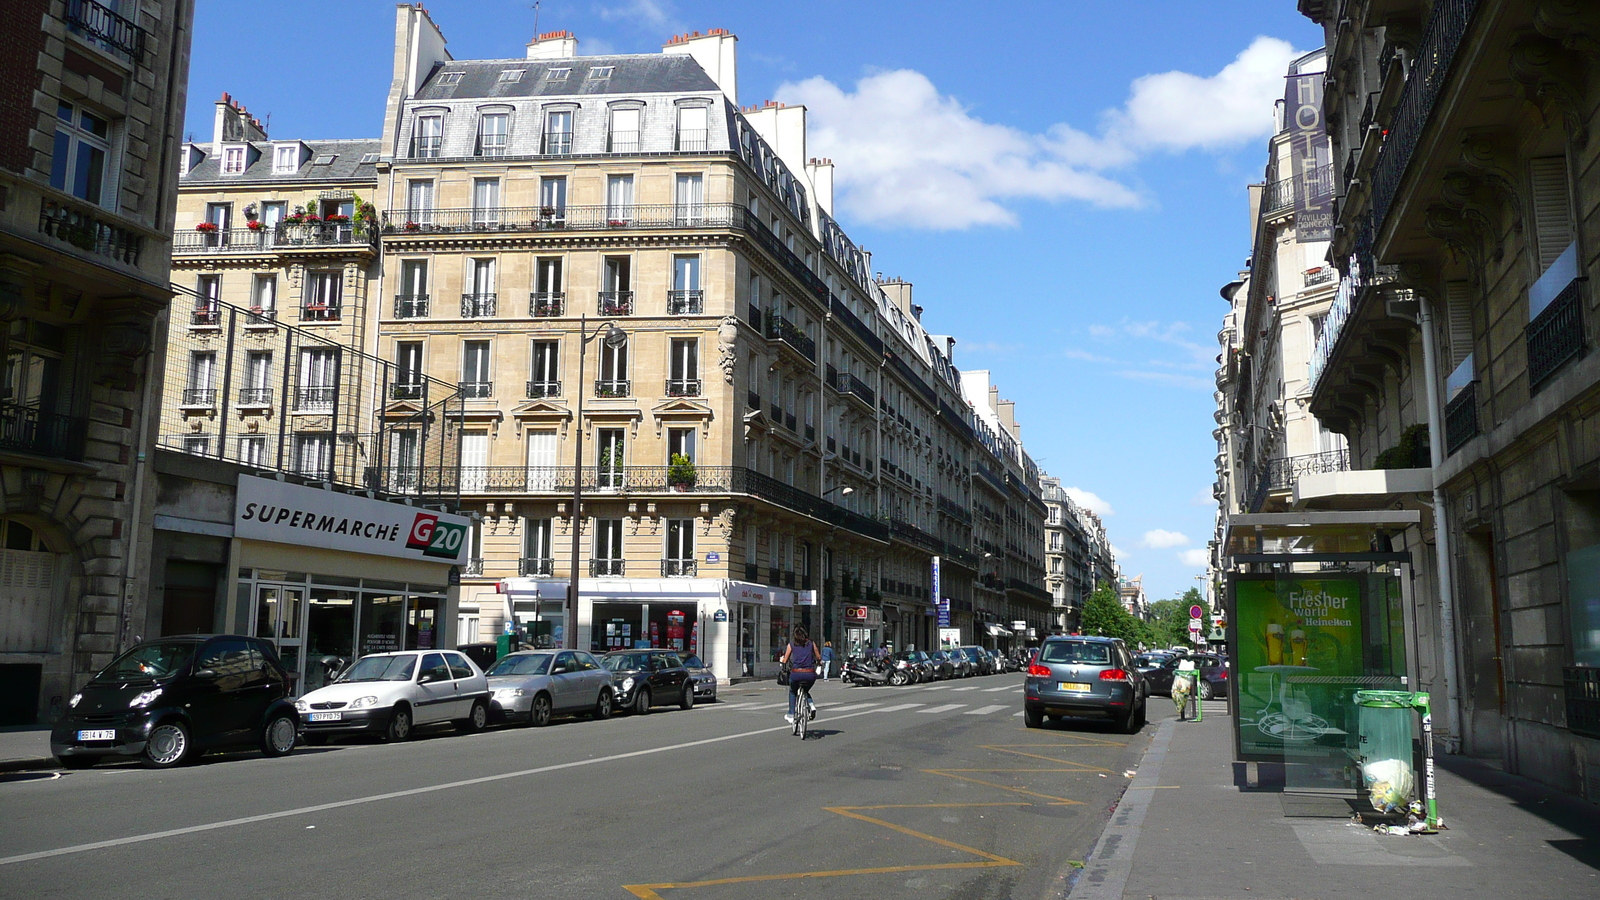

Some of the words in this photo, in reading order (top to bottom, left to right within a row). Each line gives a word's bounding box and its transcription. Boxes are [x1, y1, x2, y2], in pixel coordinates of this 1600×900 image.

[1295, 77, 1321, 211] HOTEL
[241, 502, 400, 542] SUPERMARCHÉ
[413, 518, 463, 551] G20
[1289, 591, 1348, 609] Fresher
[1294, 607, 1328, 617] world
[1305, 617, 1352, 627] Heineken
